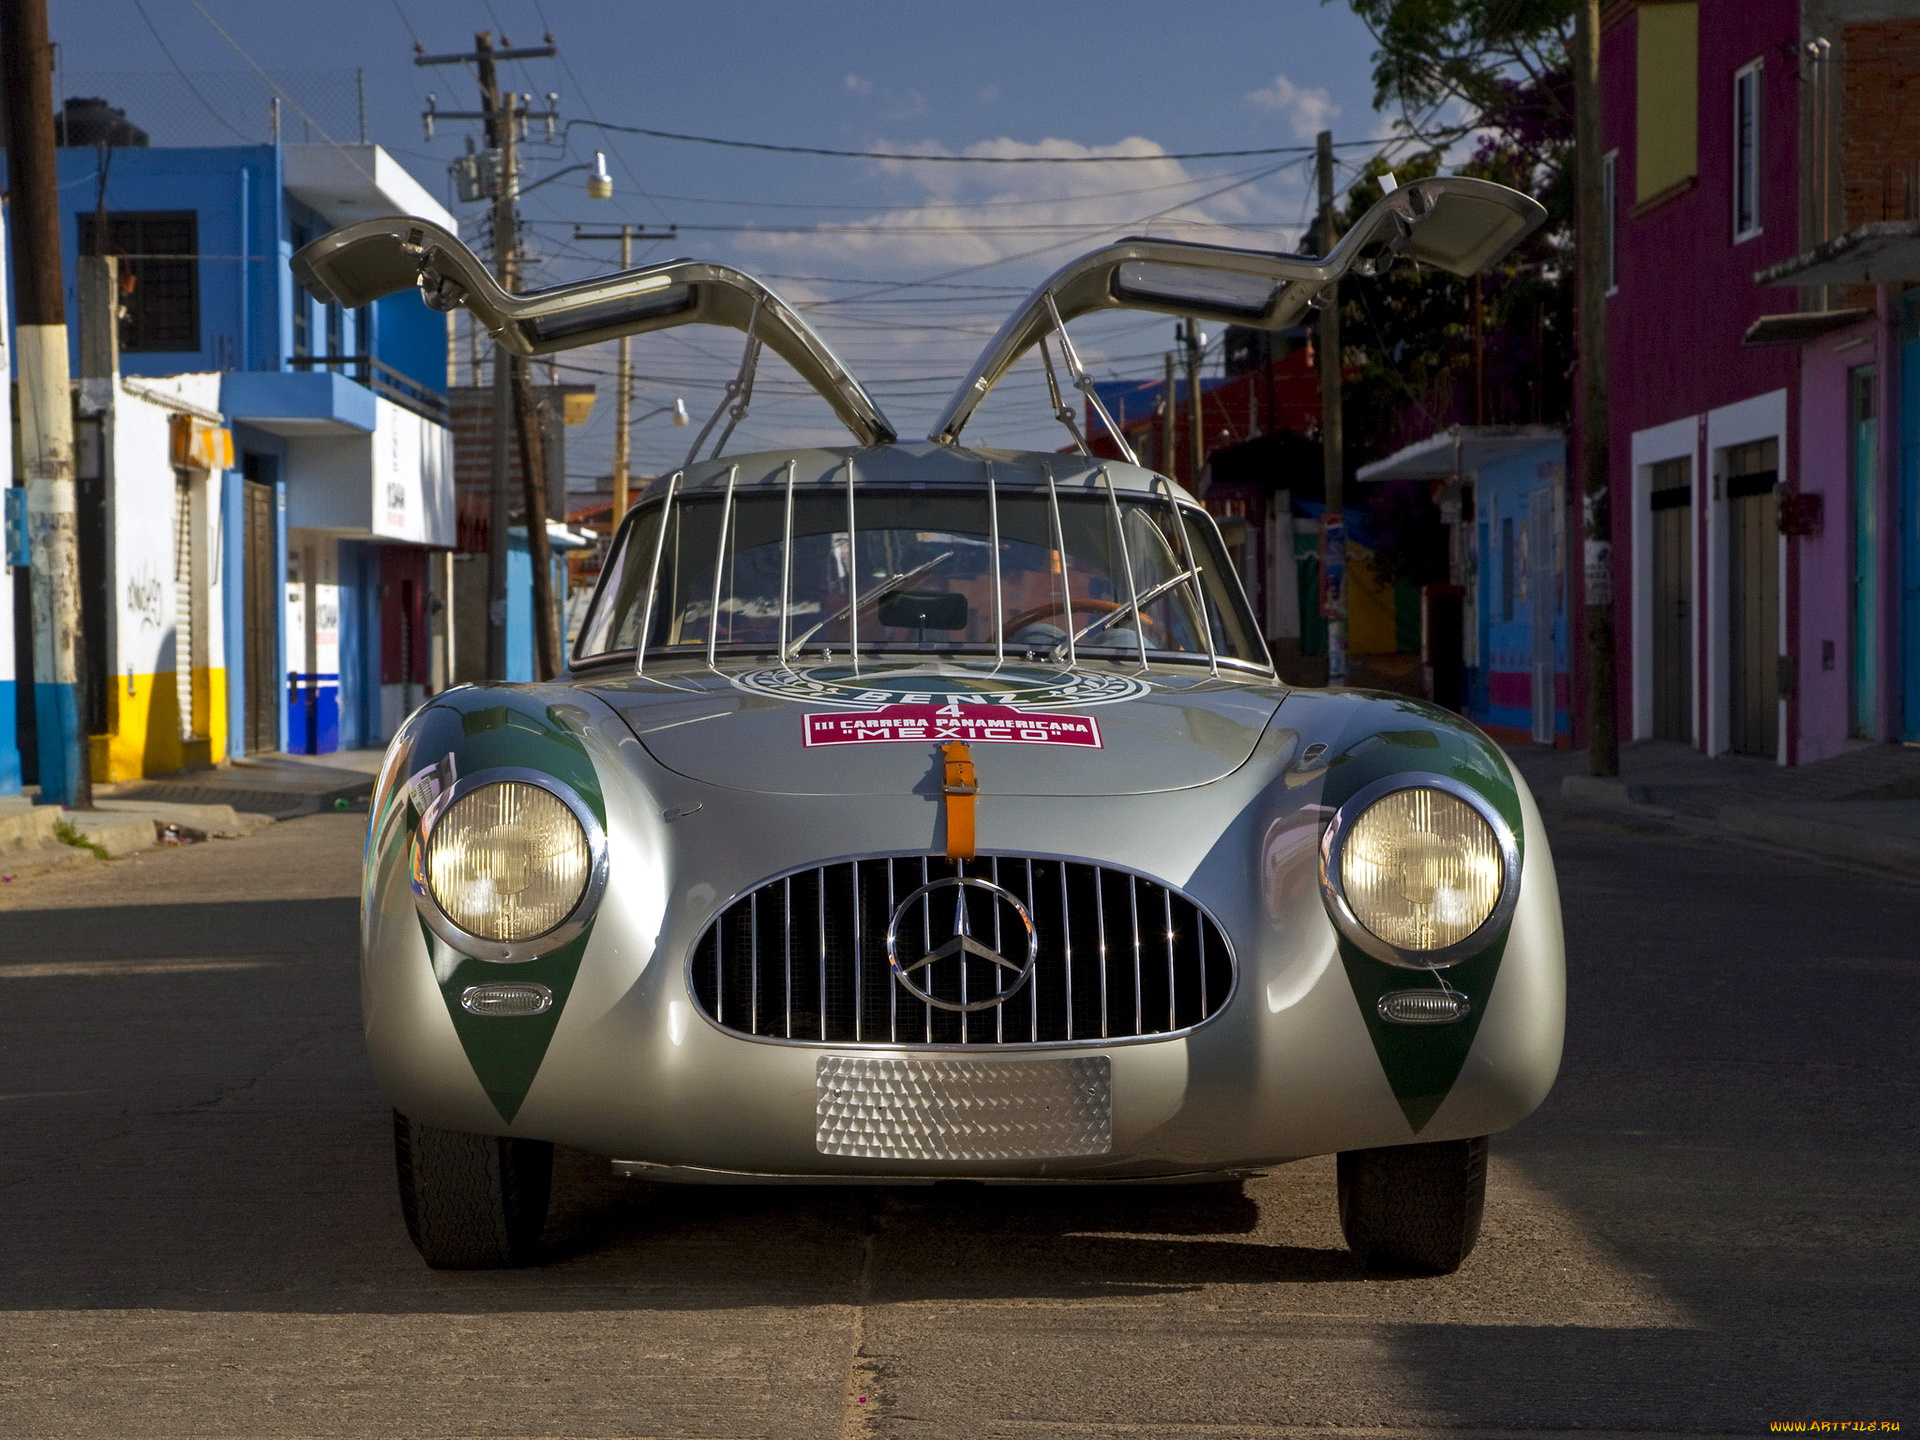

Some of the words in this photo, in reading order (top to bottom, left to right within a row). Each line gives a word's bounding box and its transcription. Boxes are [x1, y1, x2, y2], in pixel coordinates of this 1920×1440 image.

[853, 691, 1030, 705] BENZ
[935, 704, 965, 717] 4
[814, 721, 835, 731] III
[840, 718, 929, 729] CARRERA
[935, 718, 1089, 733] PANAMERICANA
